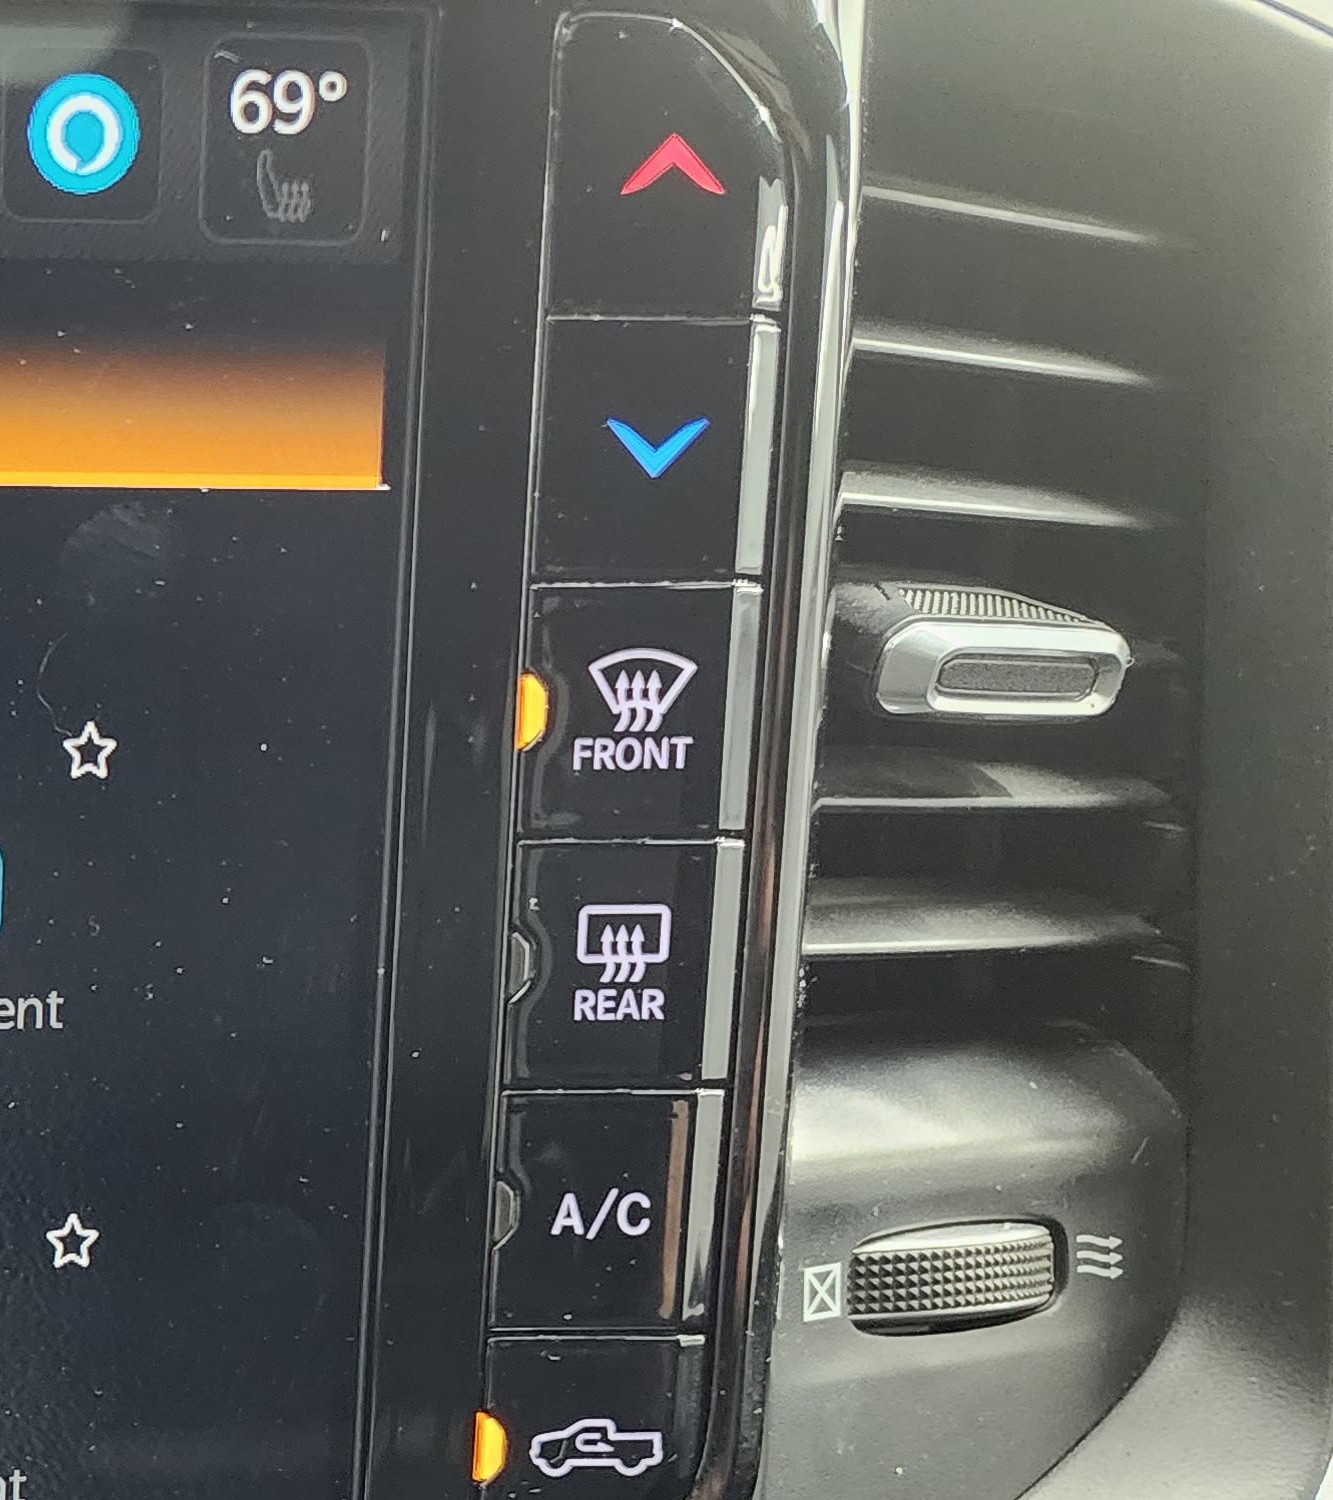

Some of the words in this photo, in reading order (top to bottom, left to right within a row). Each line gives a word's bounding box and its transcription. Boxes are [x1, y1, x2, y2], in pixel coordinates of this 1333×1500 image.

[228, 68, 347, 134] 69°
[573, 736, 693, 771] FRONT
[573, 988, 665, 1021] REAR
[550, 1187, 651, 1239] A/C
